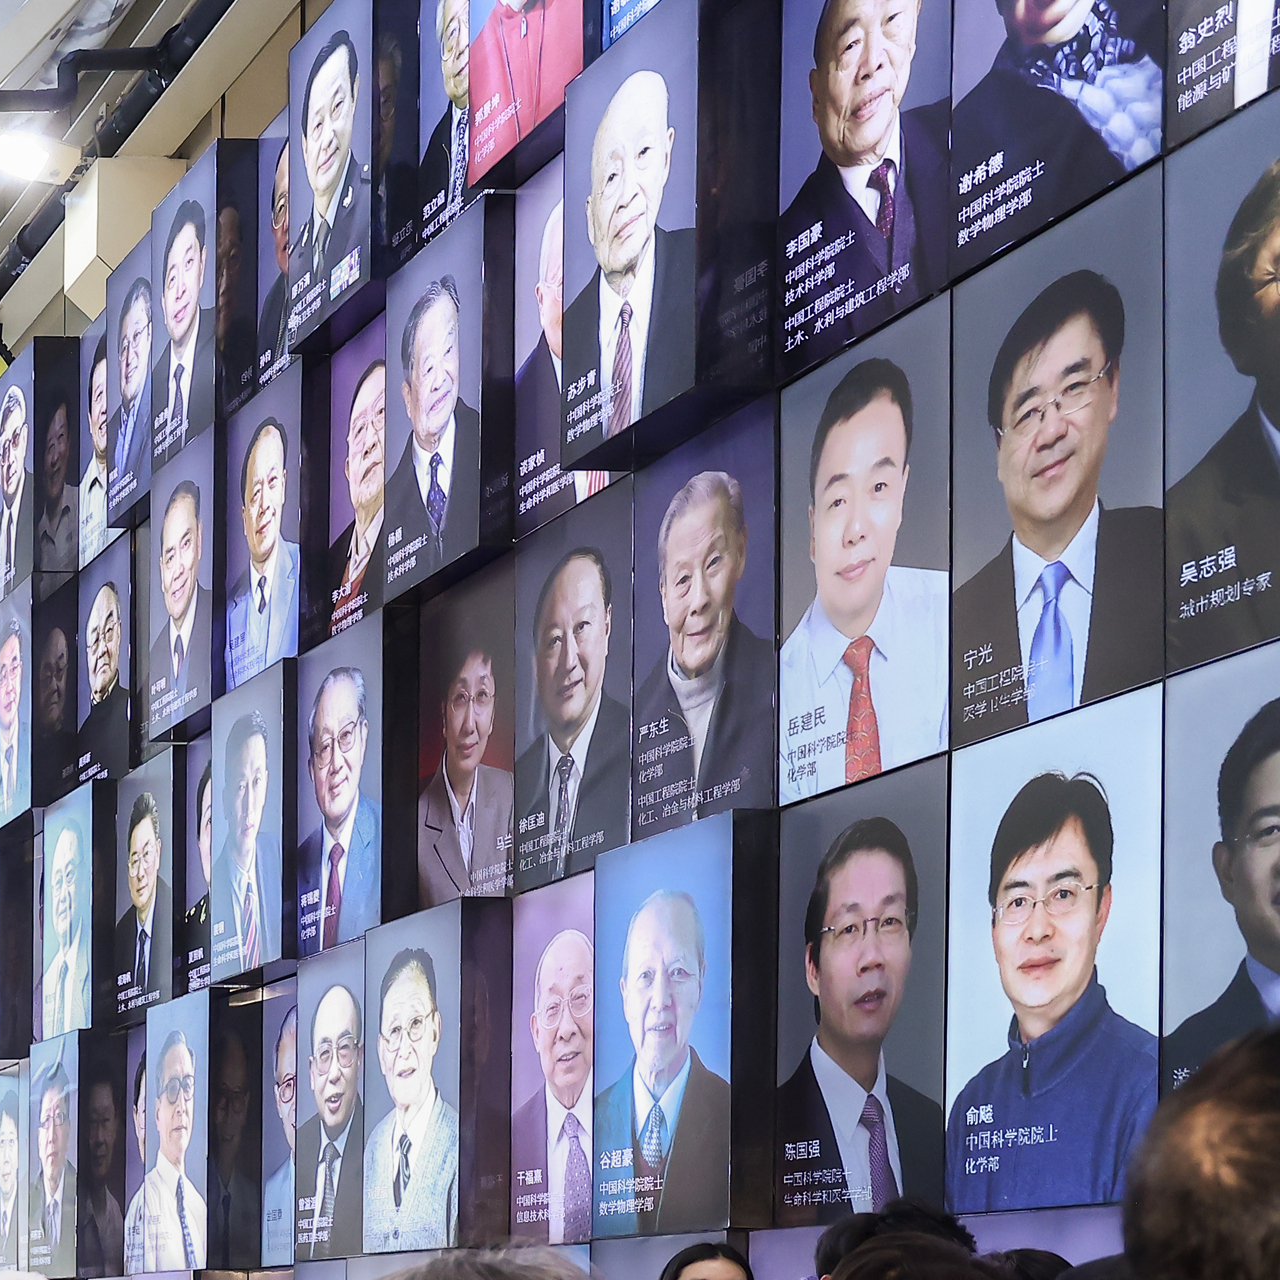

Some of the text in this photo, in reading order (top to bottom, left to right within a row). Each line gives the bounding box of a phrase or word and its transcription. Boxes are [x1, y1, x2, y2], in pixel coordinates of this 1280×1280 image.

[1178, 1, 1234, 54] 翁史烈
[959, 151, 1004, 194] 谢希德
[958, 160, 1045, 223] 中国科学院院士
[957, 188, 1033, 248] 数学物理学部
[785, 221, 823, 259] 李国豪
[785, 230, 856, 285] 中国科学院院士
[784, 262, 836, 307] 技术科学部
[784, 278, 856, 331] 中国工程院院士
[784, 263, 910, 353] 土木、水利与建筑工程学部
[567, 369, 596, 402] 苏步青
[567, 379, 622, 425] 中国科学院院士
[566, 401, 615, 444] 数学物理学部
[519, 449, 545, 476] 谈家桢
[1180, 545, 1237, 587] 吴志强
[1179, 571, 1272, 619] 城市规划专家
[963, 643, 993, 670] 宁光
[638, 717, 670, 744] 严东生
[788, 706, 826, 737] 岳建民
[638, 733, 697, 765] 中国科学院院士
[639, 763, 664, 784] 化学部
[787, 761, 817, 784] 化学部
[637, 776, 698, 808] 中国工程院院士
[518, 811, 545, 834] 徐匡迪
[496, 833, 513, 851] 马兰
[470, 858, 514, 883] 中国科学院院士
[784, 1139, 821, 1161] 陈国强
[965, 1124, 1058, 1151] 中国科学院院士
[600, 1148, 633, 1170] 谷超豪
[965, 1156, 1000, 1174] 化学部
[600, 1174, 664, 1195] 中国科学院院士
[784, 1166, 852, 1186] 中国科学院院士
[599, 1196, 654, 1216] 数学物理学部
